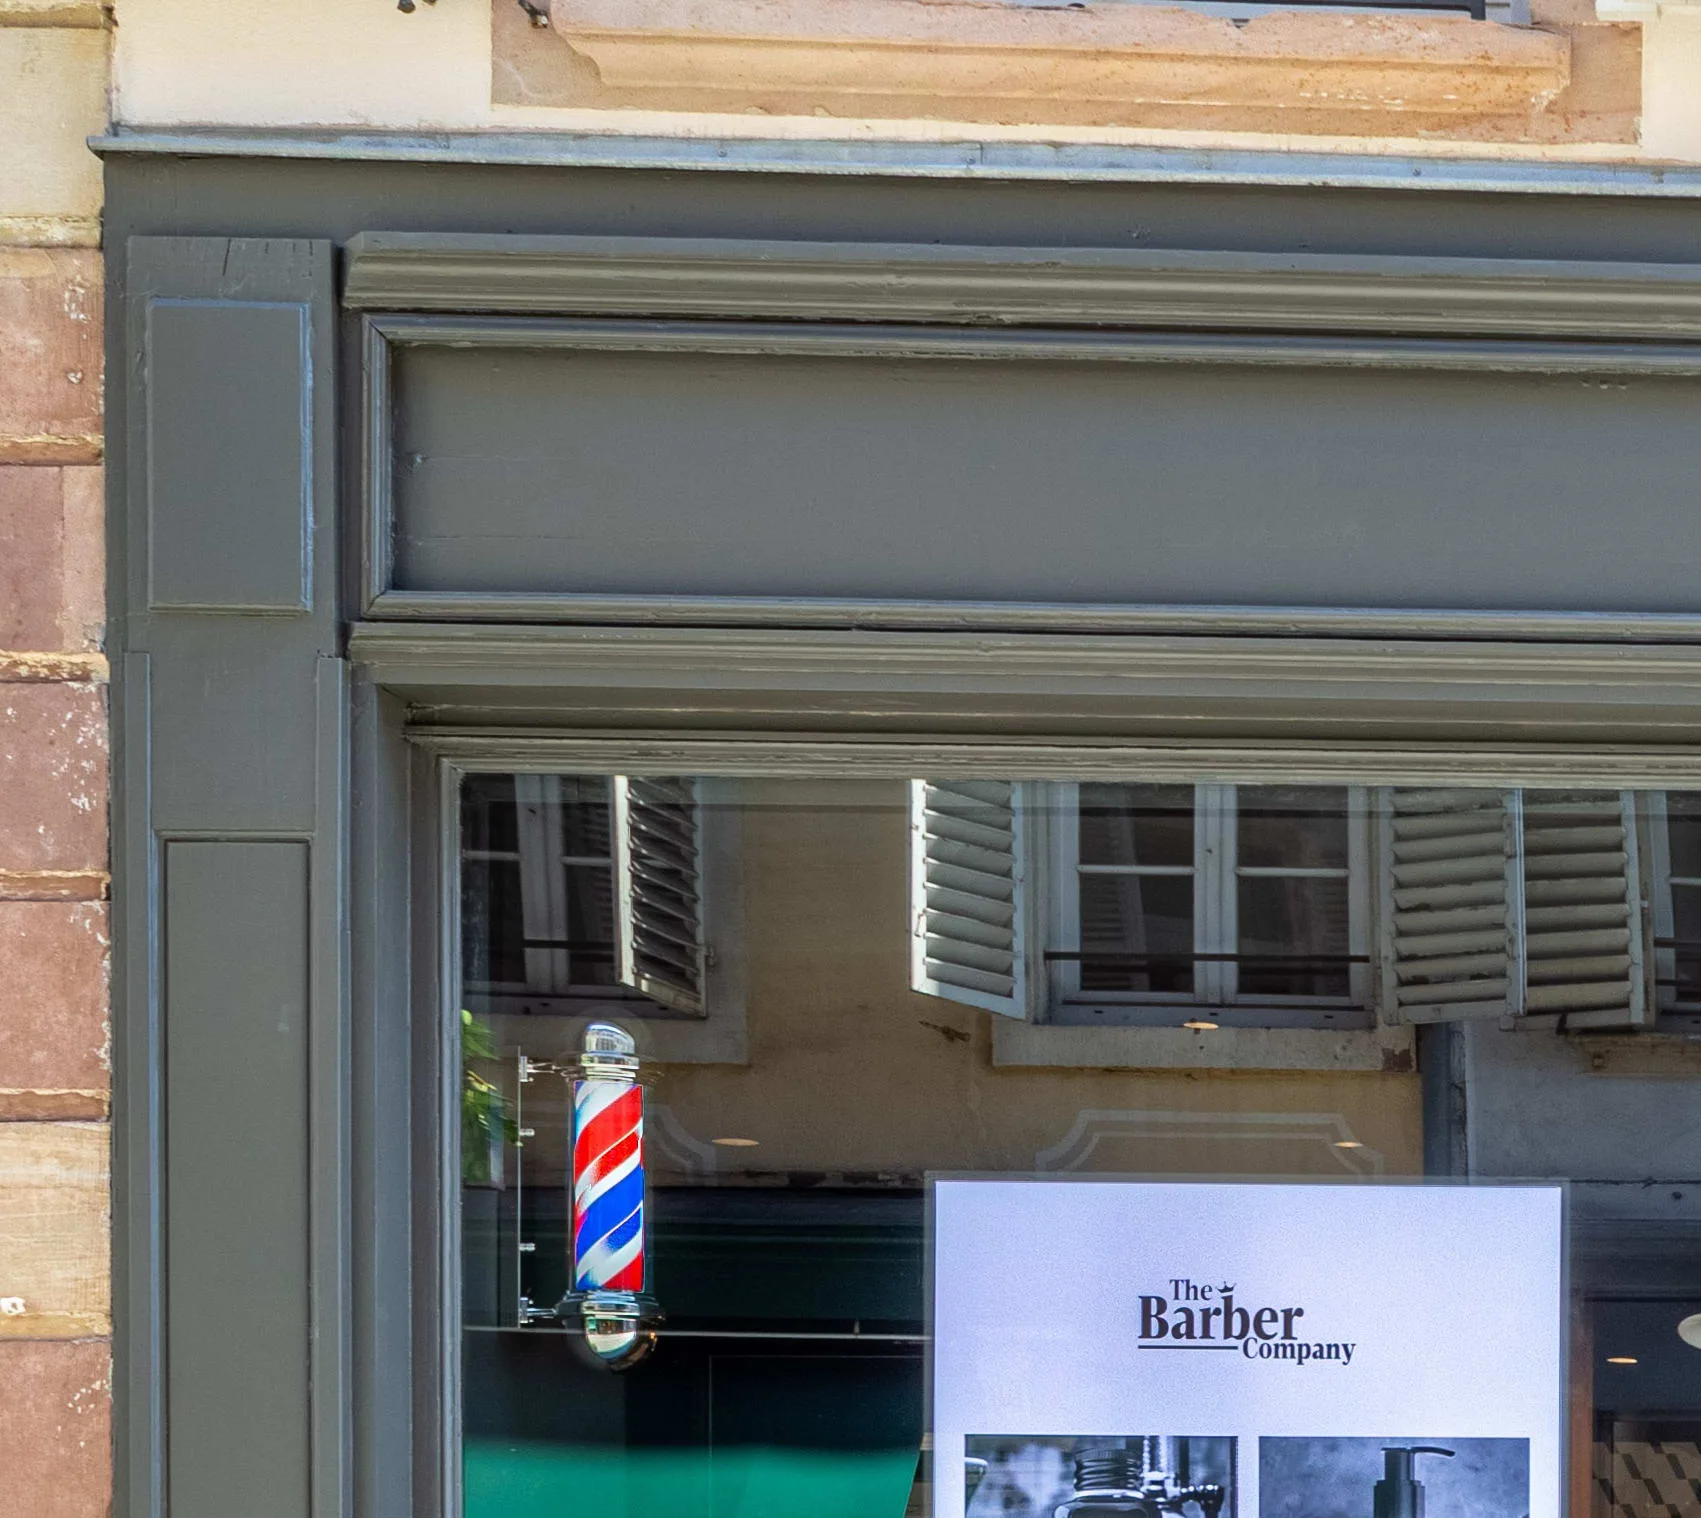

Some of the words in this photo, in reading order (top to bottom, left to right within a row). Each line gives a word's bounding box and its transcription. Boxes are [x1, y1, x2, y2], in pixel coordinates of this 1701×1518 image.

[1169, 1279, 1213, 1301] The
[1138, 1293, 1303, 1341] Barber
[1242, 1338, 1356, 1366] Company
